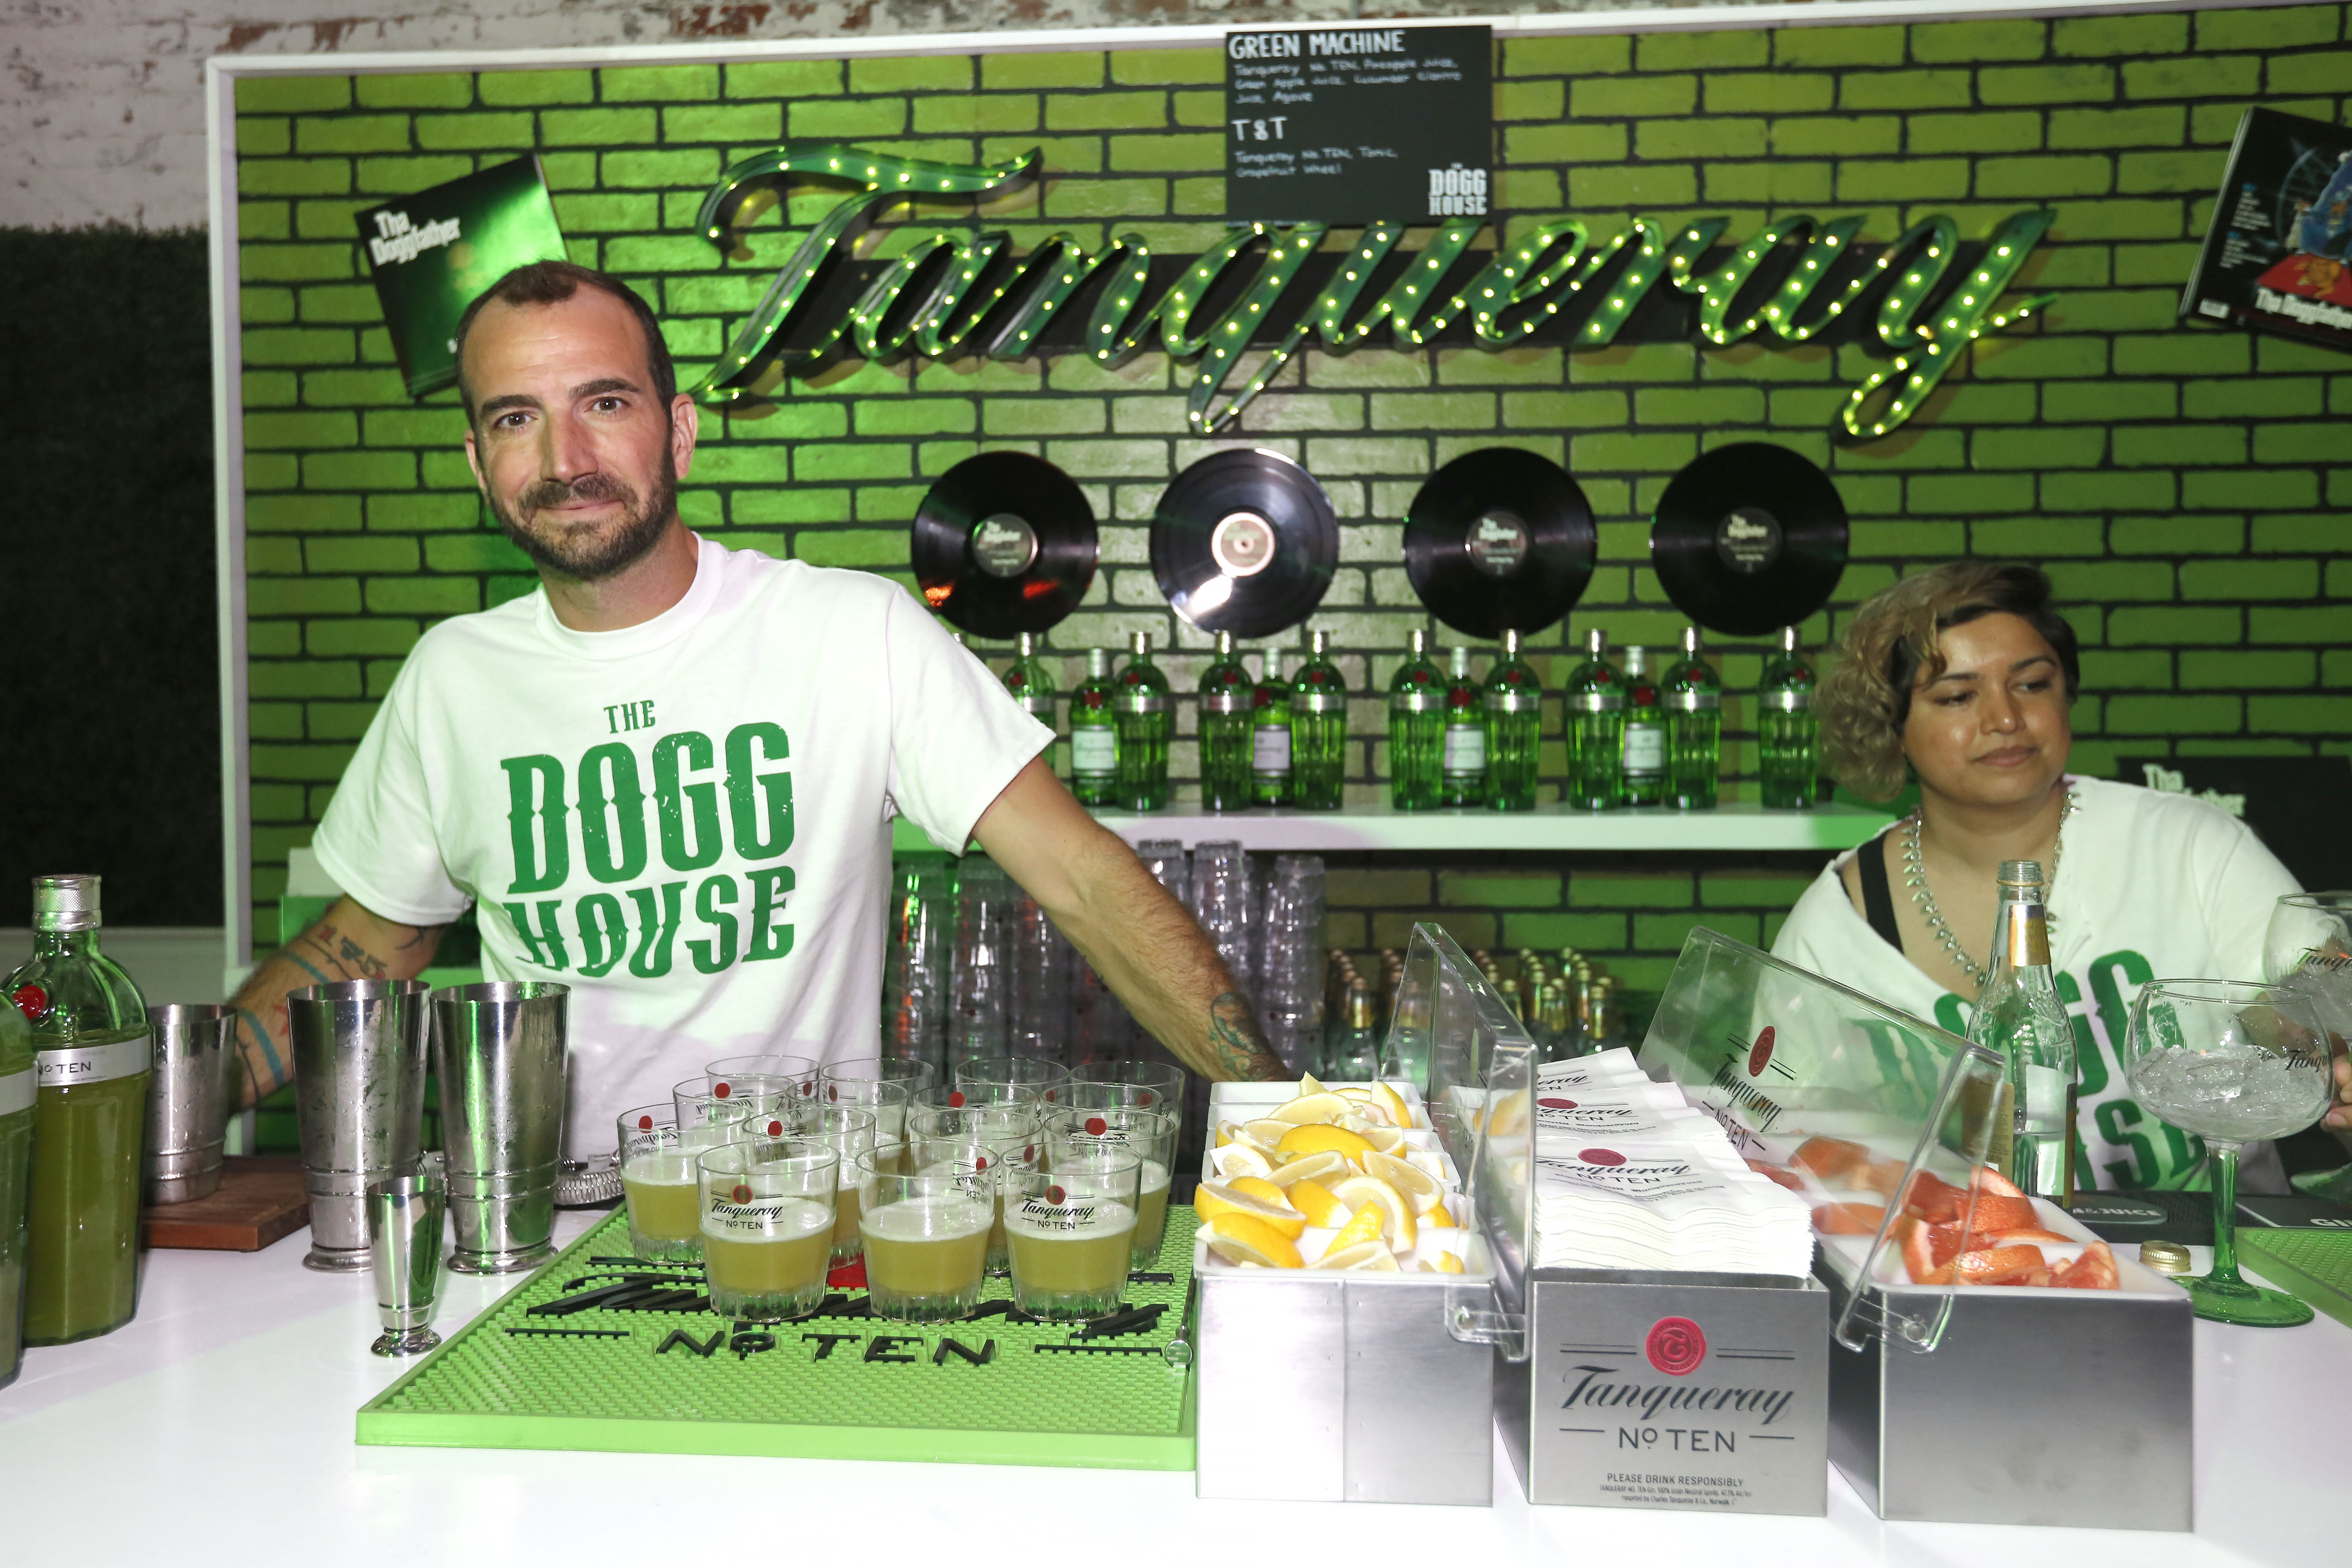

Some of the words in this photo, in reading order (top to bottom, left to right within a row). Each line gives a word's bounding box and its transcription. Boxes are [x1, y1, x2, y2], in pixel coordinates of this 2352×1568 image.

[1228, 33, 1301, 59] GREEN
[1308, 29, 1406, 56] MACHINE
[1272, 90, 1314, 105] Agave
[1428, 168, 1487, 196] DOGG
[1428, 196, 1488, 216] HOUSE
[692, 143, 2057, 436] Tanqueray
[604, 699, 655, 734] THE
[500, 722, 795, 894] DOGG
[501, 866, 796, 978] HOUSE
[56, 1061, 91, 1074] TEN
[1709, 1053, 1782, 1133] Tanqueray
[1727, 1118, 1750, 1150] TEN
[710, 1198, 784, 1220] Tanqueray
[1022, 1198, 1095, 1220] Tanqueray
[740, 1221, 763, 1229] TEN
[1052, 1221, 1075, 1229] TEN
[802, 1333, 995, 1366] TEN
[1559, 1364, 1795, 1425] Tanqueray
[1666, 1429, 1735, 1453] TEN
[1607, 1473, 1642, 1483] PLEASE
[1646, 1474, 1675, 1483] DRINK
[1669, 1496, 1693, 1504] Tanqueray
